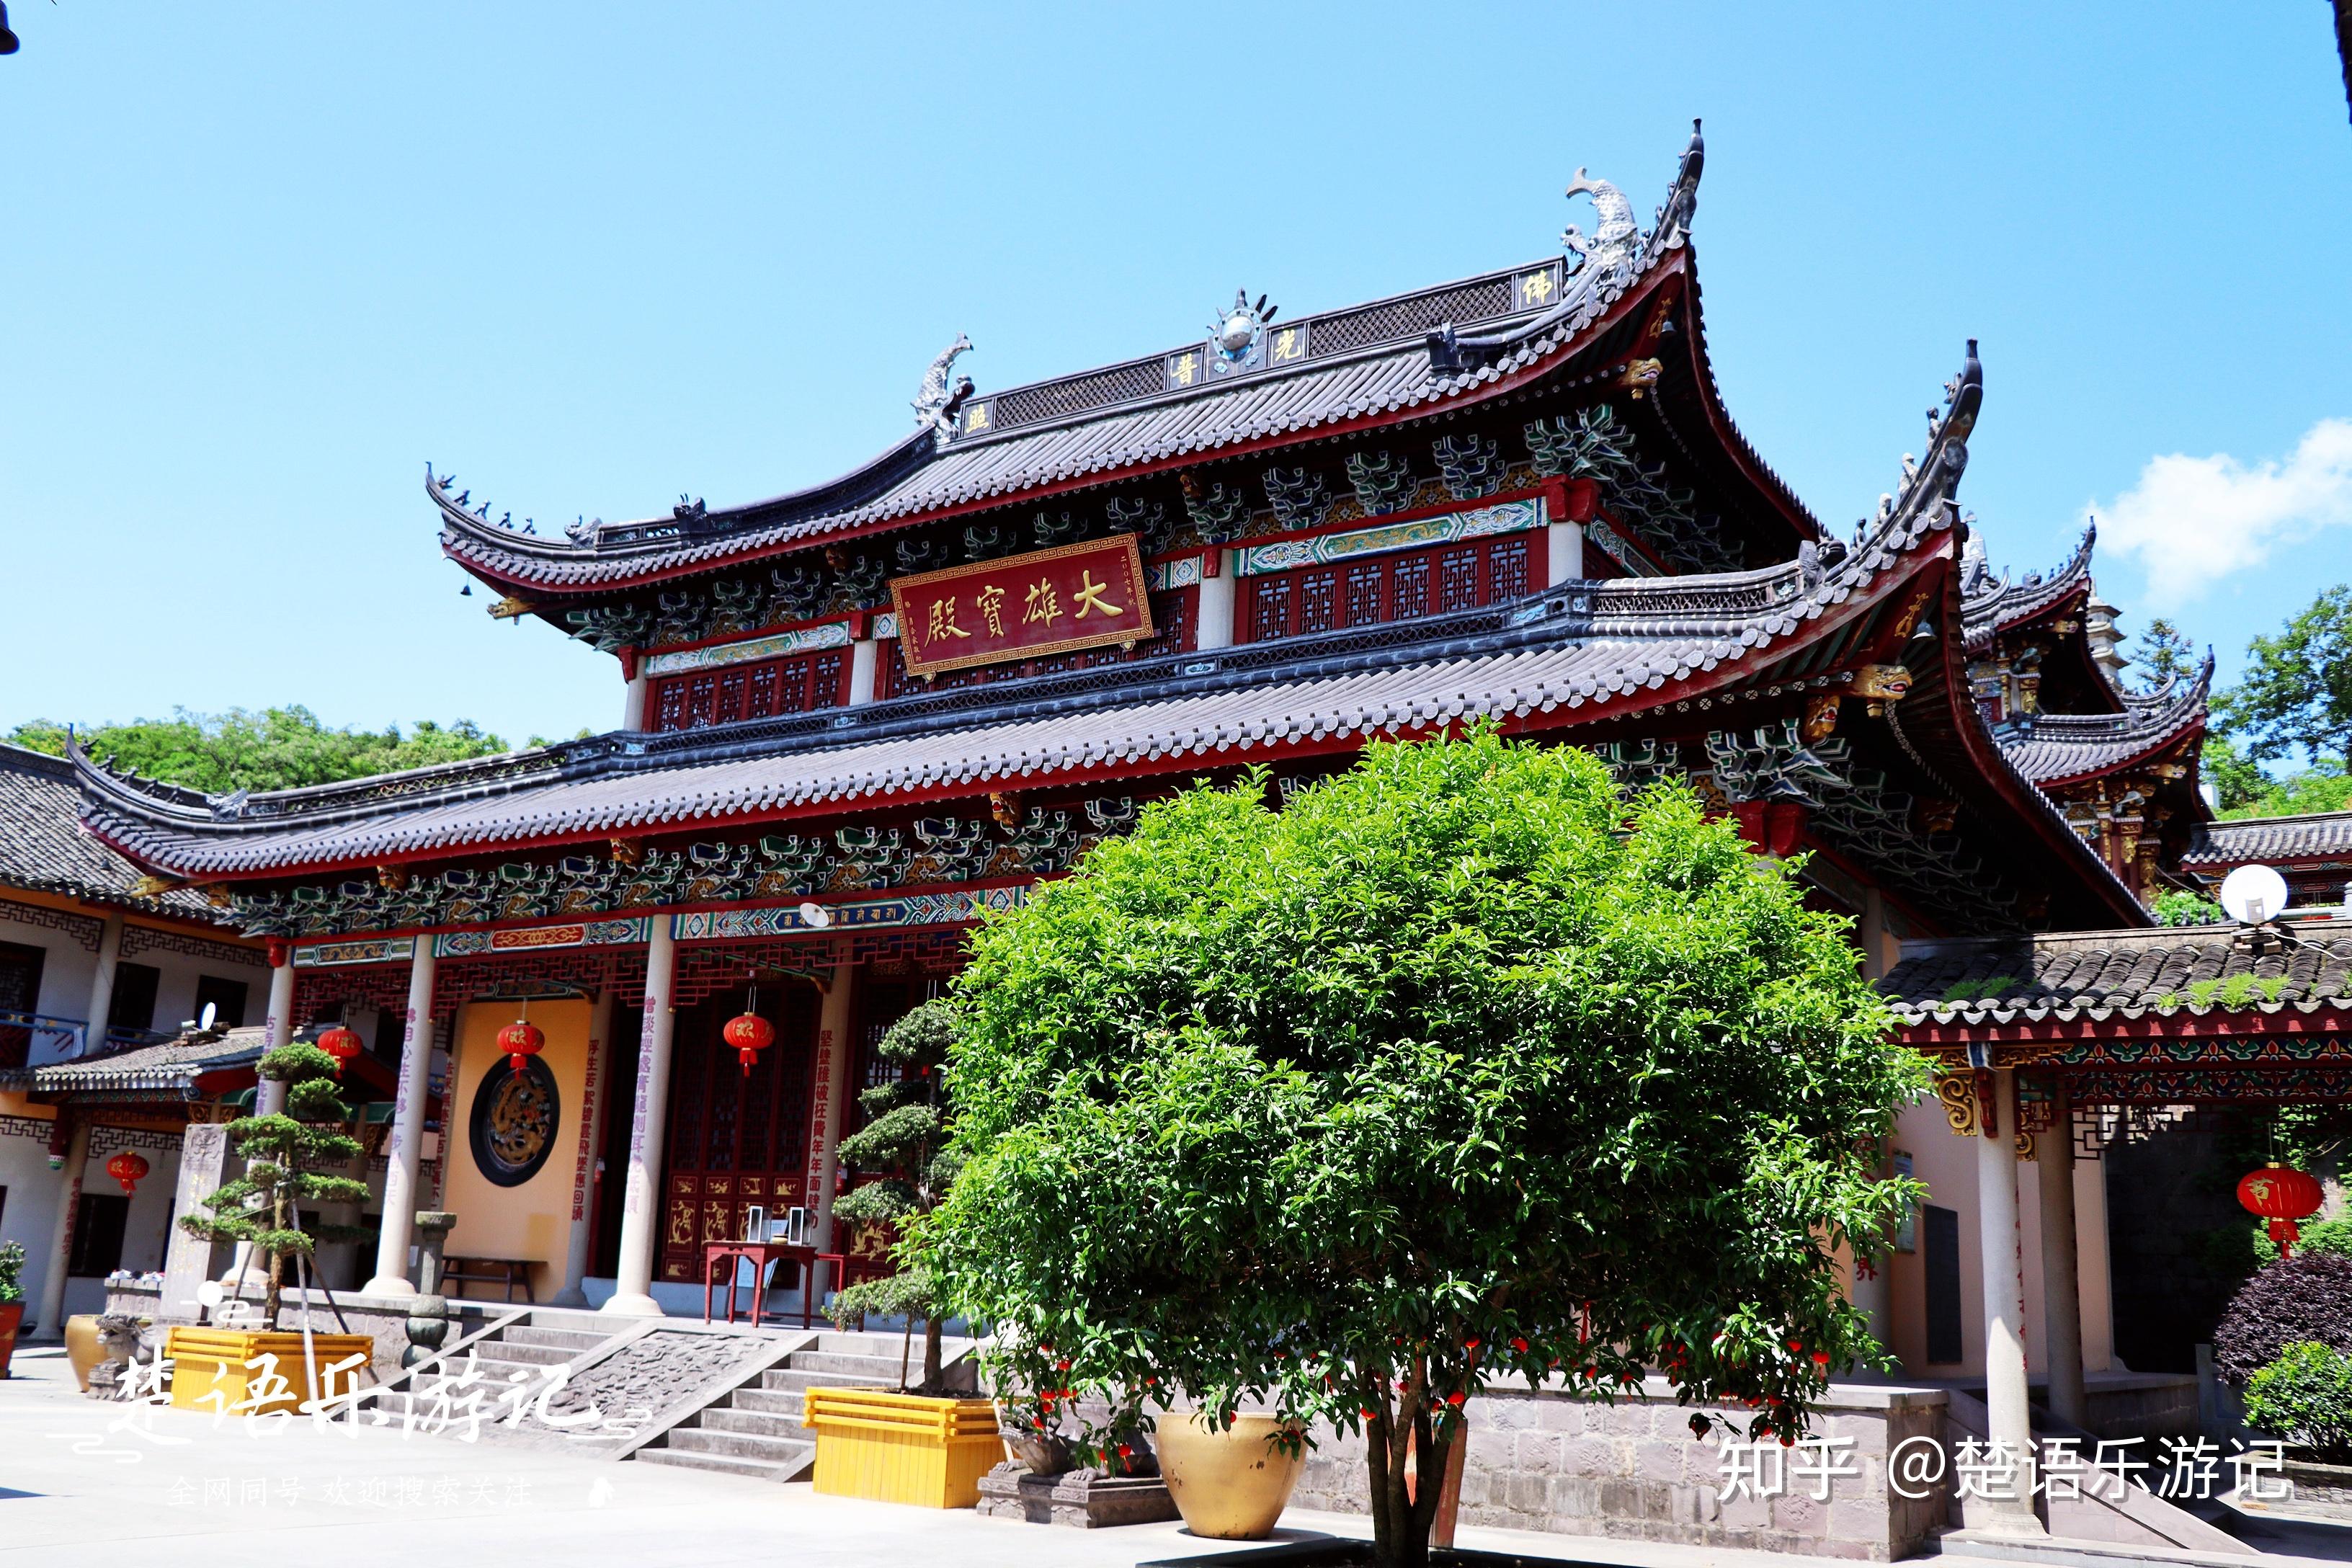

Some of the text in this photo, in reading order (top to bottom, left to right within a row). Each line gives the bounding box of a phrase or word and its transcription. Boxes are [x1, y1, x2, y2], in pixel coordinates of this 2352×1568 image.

[966, 269, 1554, 434] 佛 光 普 照
[924, 569, 1125, 648] 大雄寶殿
